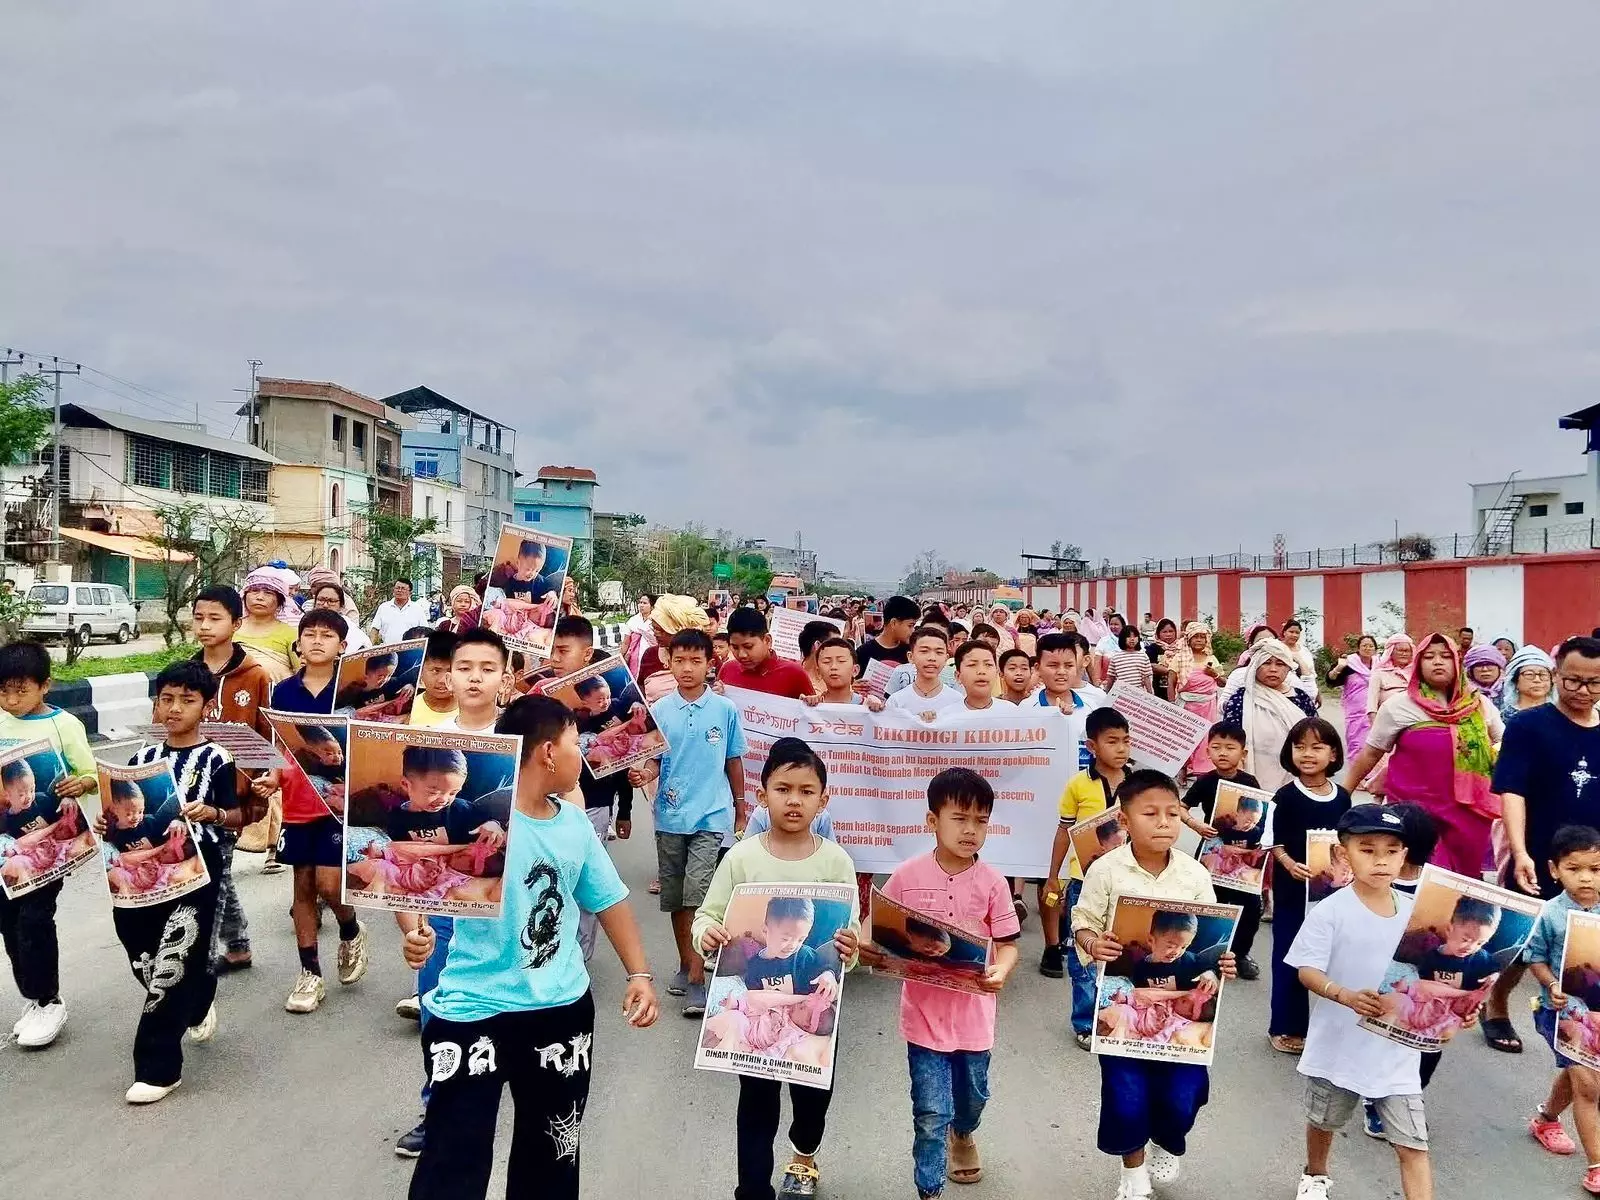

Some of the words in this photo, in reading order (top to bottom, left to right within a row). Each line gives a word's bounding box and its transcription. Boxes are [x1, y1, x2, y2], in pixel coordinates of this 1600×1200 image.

[872, 726, 958, 744] EIKHOIGI
[964, 728, 1047, 744] KHOLLAO
[828, 750, 860, 761] Tumliba
[862, 752, 890, 765] Angang
[892, 754, 904, 764] ani
[906, 754, 916, 764] bu
[950, 755, 976, 765] amadi
[977, 756, 1000, 766] Mama
[872, 766, 912, 778] Chennaba
[854, 787, 879, 798] amadi
[880, 790, 904, 800] maral
[1000, 792, 1034, 802] security
[886, 824, 922, 835] separate
[842, 836, 873, 845] cheirak
[705, 1050, 729, 1060] OINAM
[729, 1052, 762, 1064] TOMTHIN
[762, 1058, 768, 1066] &
[769, 1058, 793, 1069] OINAM
[794, 1064, 822, 1075] YAISANA
